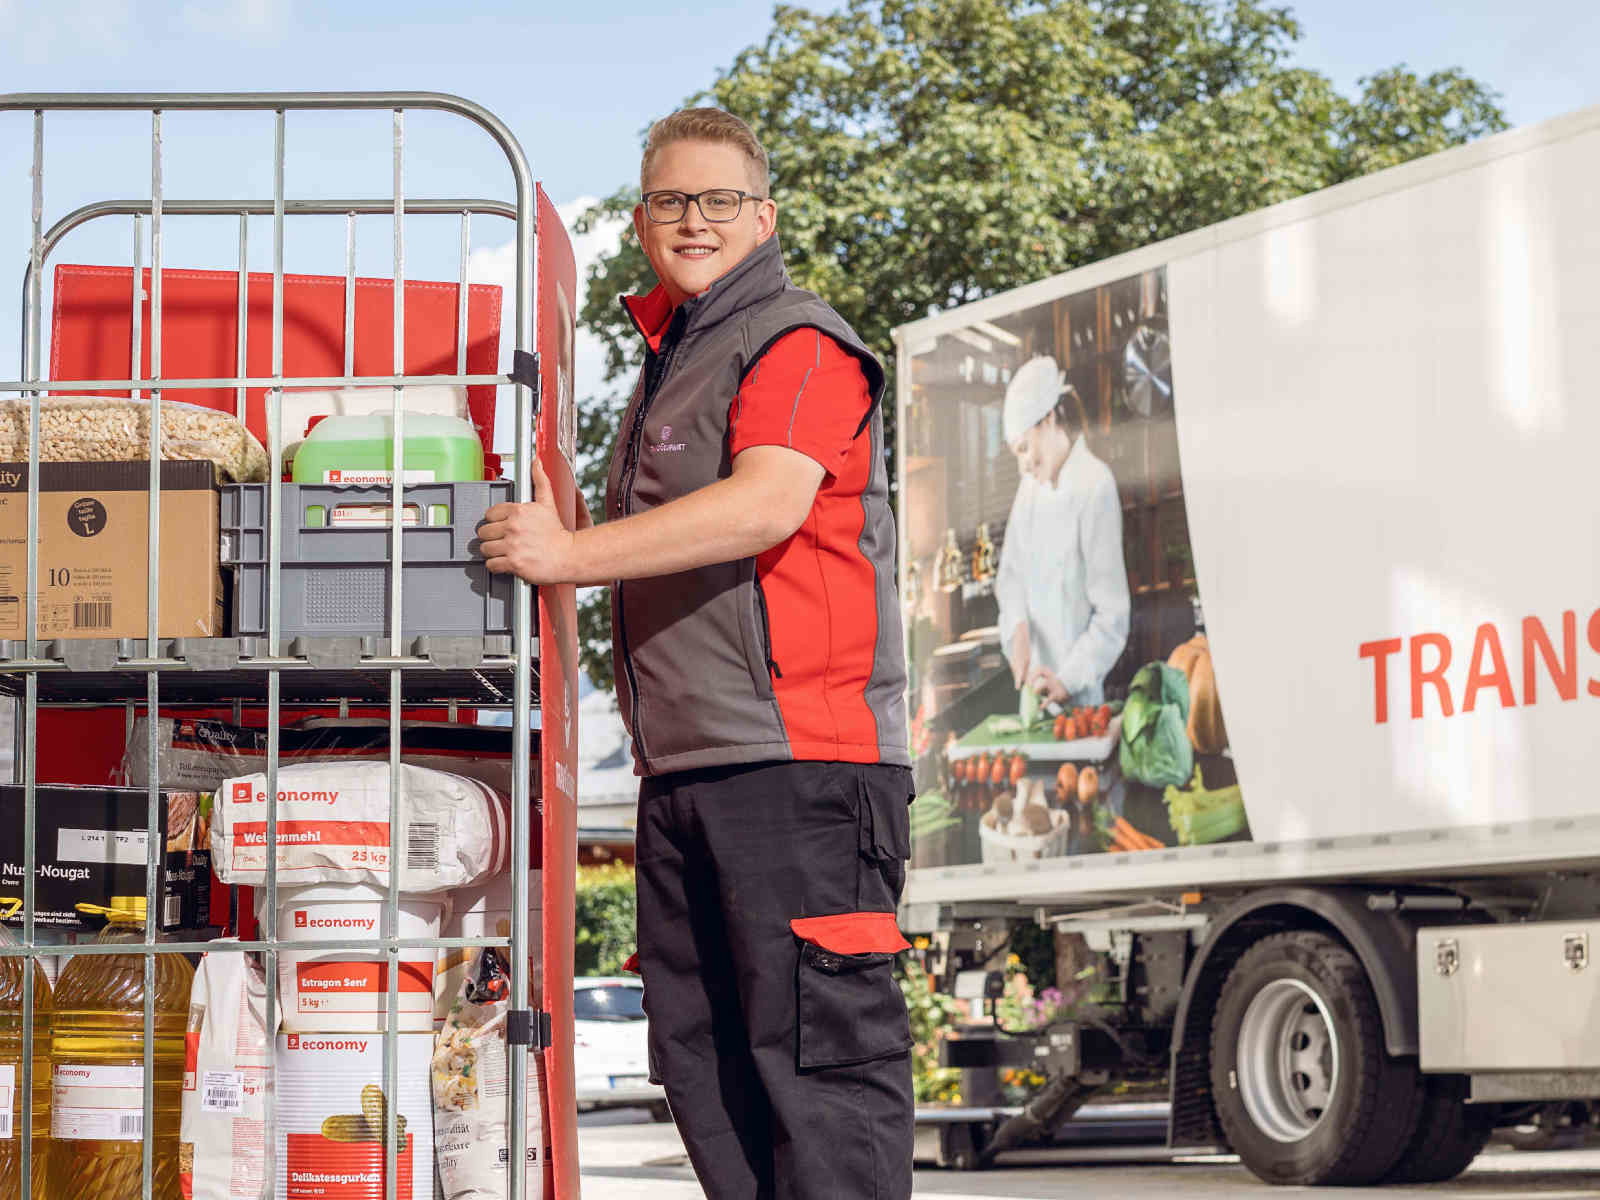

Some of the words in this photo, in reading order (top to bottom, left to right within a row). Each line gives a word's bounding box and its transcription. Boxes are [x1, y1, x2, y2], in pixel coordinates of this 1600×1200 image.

[0, 470, 21, 487] ity
[344, 476, 392, 485] economy
[48, 567, 71, 587] 10
[256, 791, 340, 805] eonomy
[243, 831, 321, 843] Weienmehl
[351, 850, 368, 861] 25
[370, 851, 387, 865] kg
[2, 863, 91, 881] Nus-Nougat
[310, 917, 375, 930] economy
[301, 978, 342, 989] Estragon
[343, 977, 368, 987] Senf
[301, 998, 307, 1007] 5
[309, 998, 319, 1009] kg
[302, 1041, 368, 1053] economy
[243, 1084, 255, 1096] kg
